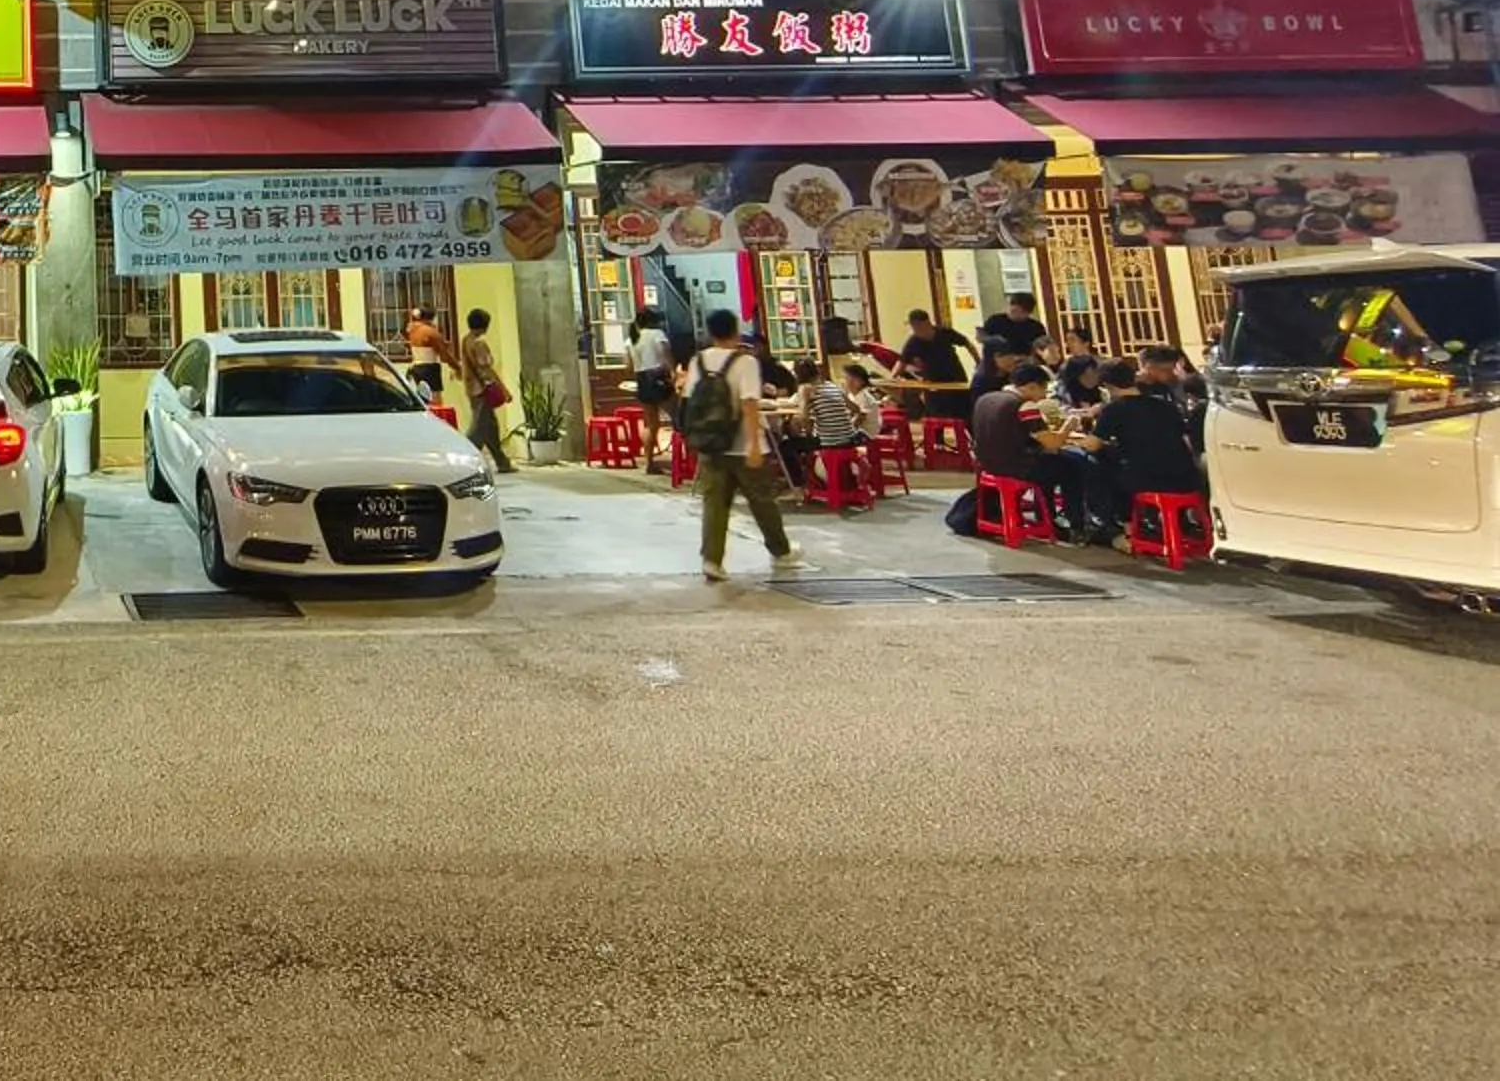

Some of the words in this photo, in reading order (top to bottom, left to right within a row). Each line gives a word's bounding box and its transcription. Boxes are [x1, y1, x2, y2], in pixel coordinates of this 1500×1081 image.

[204, 0, 325, 34] LUCK
[1085, 16, 1185, 34] LUCKY
[1262, 15, 1345, 32] BOWL
[293, 38, 371, 55] BAKERY
[187, 199, 448, 232] 全马首家丹麦千层吐司
[217, 232, 250, 251] good
[252, 231, 285, 247] luck
[349, 245, 389, 262] 016
[394, 243, 435, 260] 472
[438, 240, 492, 259] 4959
